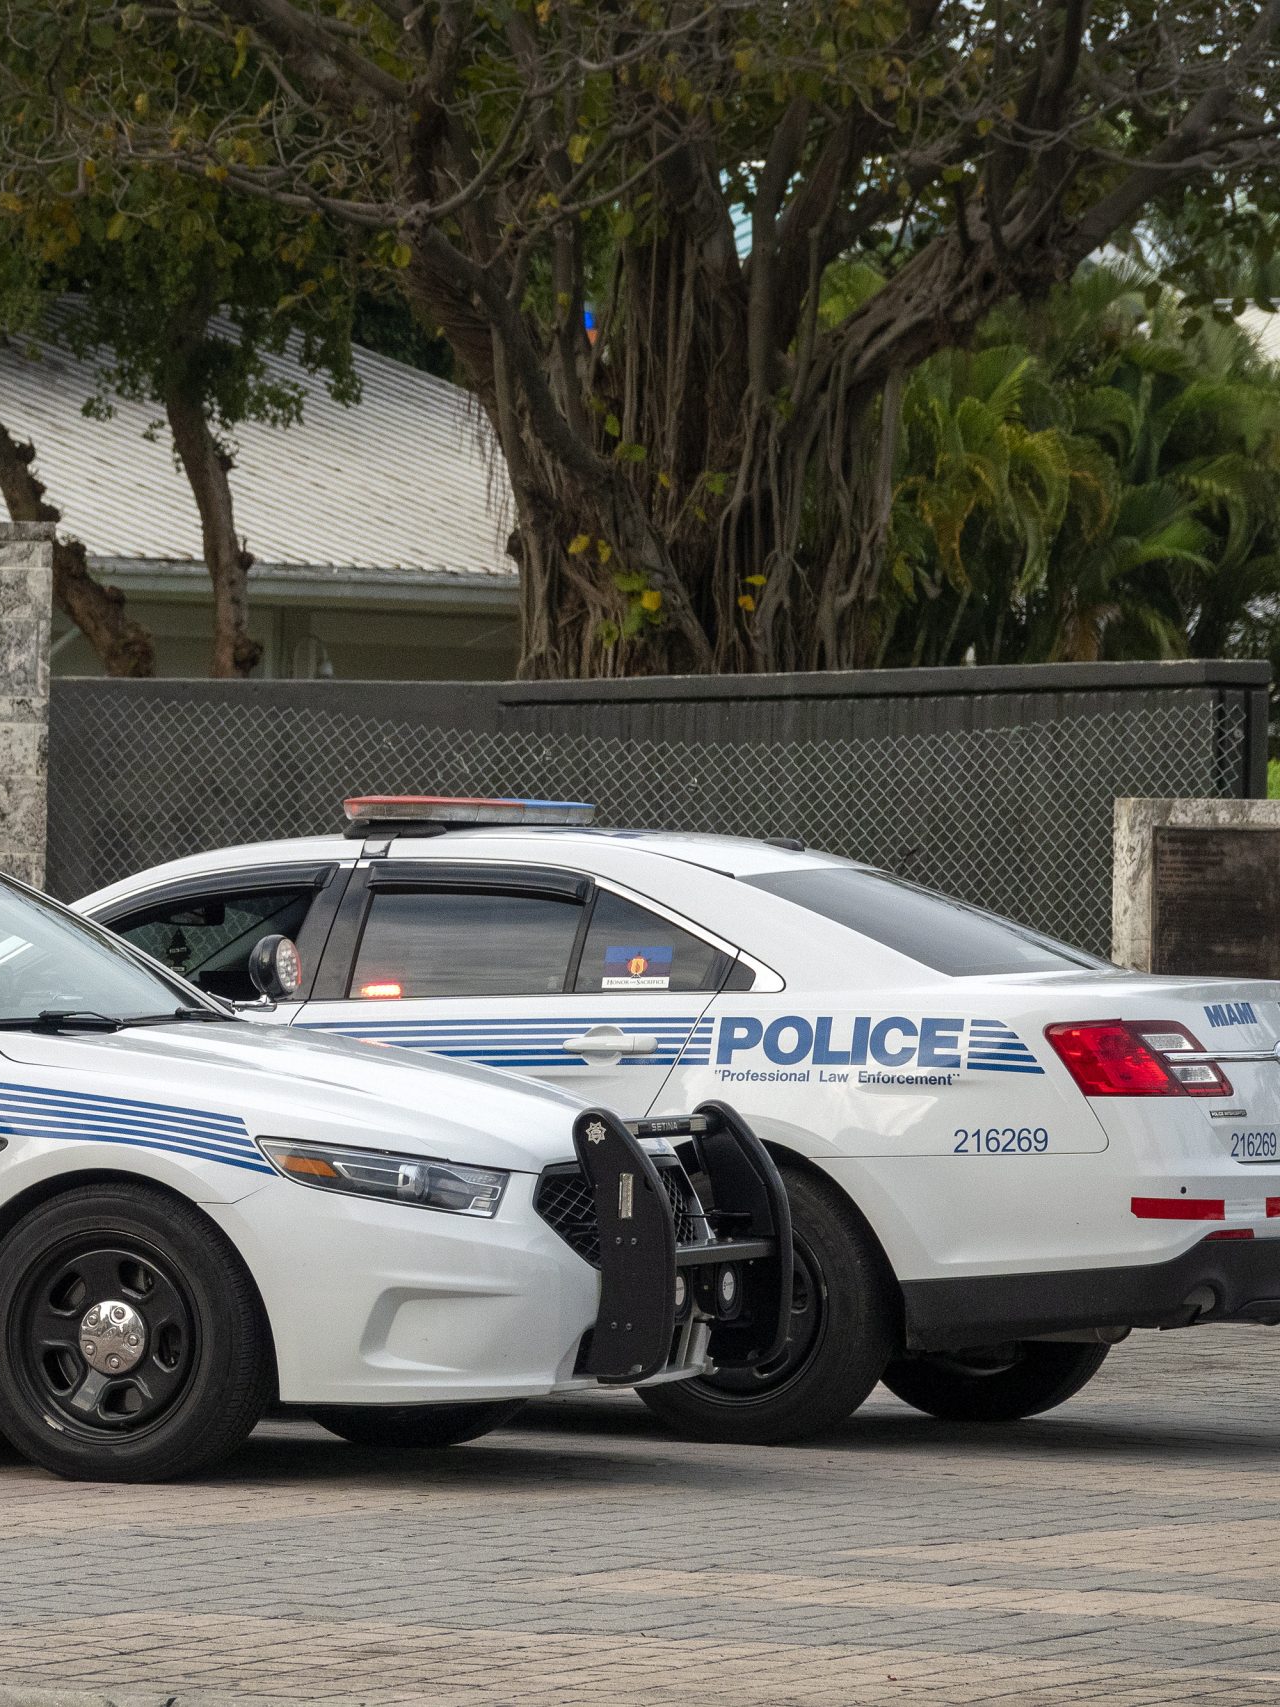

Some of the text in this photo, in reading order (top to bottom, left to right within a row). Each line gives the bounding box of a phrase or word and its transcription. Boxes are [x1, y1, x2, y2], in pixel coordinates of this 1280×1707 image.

[1204, 1002, 1258, 1028] MIAMI
[716, 1016, 965, 1068] POLICE
[819, 1071, 849, 1084] Law
[953, 1127, 1049, 1153] 216269
[1230, 1132, 1277, 1157] 216269
